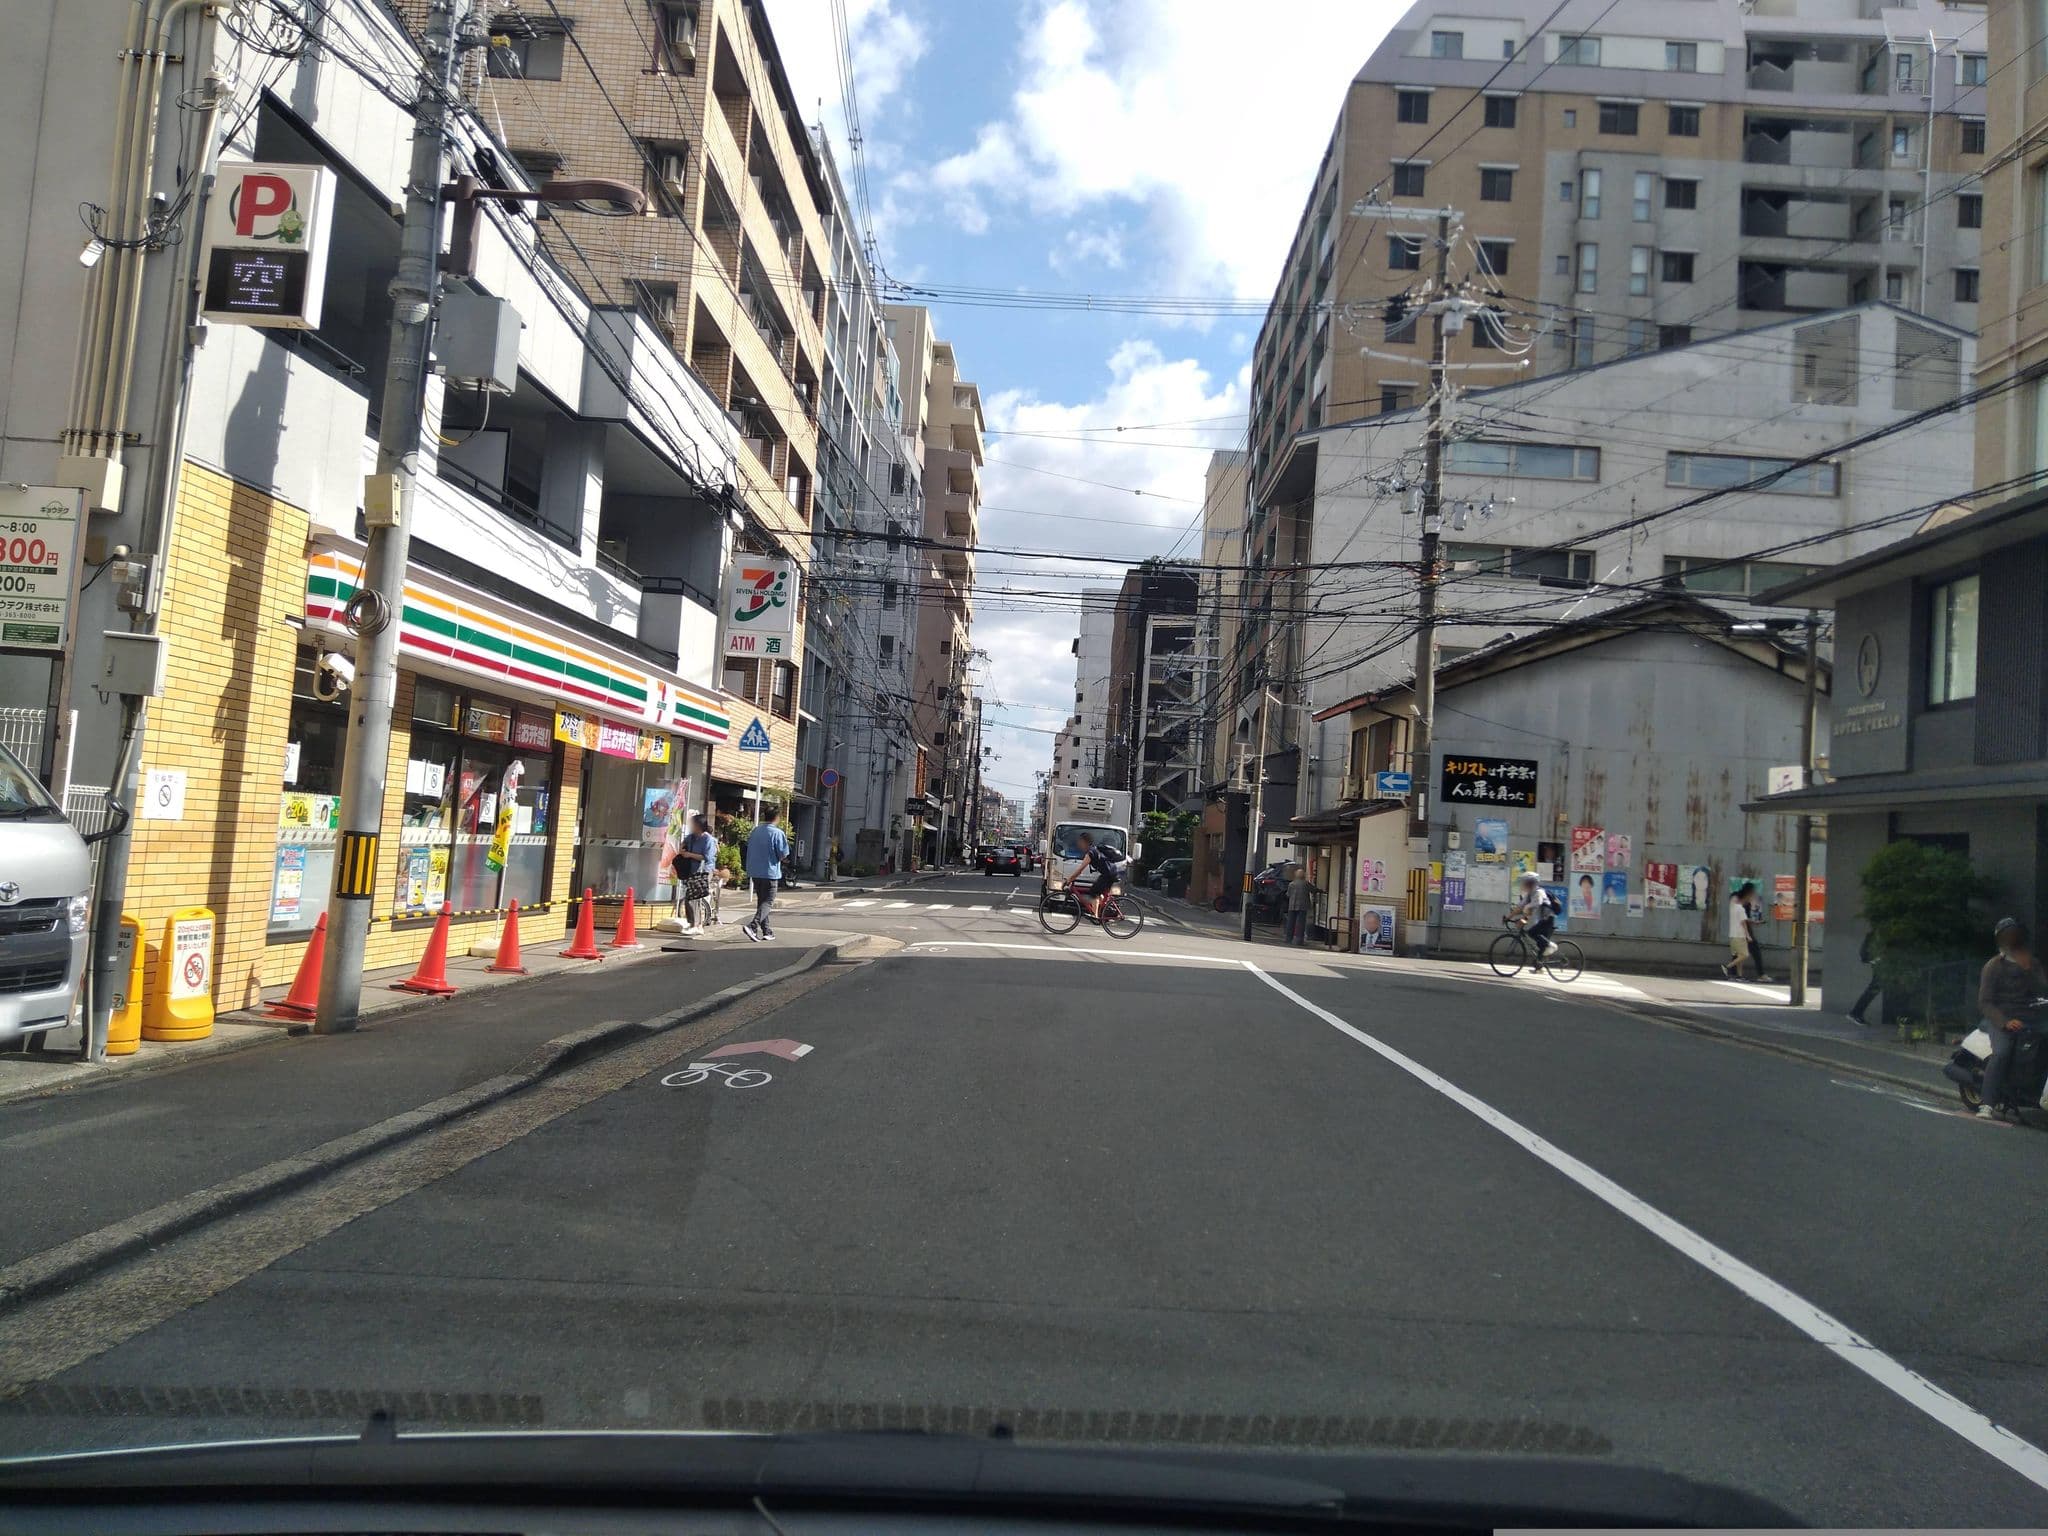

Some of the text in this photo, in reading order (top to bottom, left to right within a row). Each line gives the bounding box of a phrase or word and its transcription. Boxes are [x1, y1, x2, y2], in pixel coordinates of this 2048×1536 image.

[236, 174, 292, 236] P
[730, 635, 756, 651] ATM
[765, 637, 782, 654] 酒
